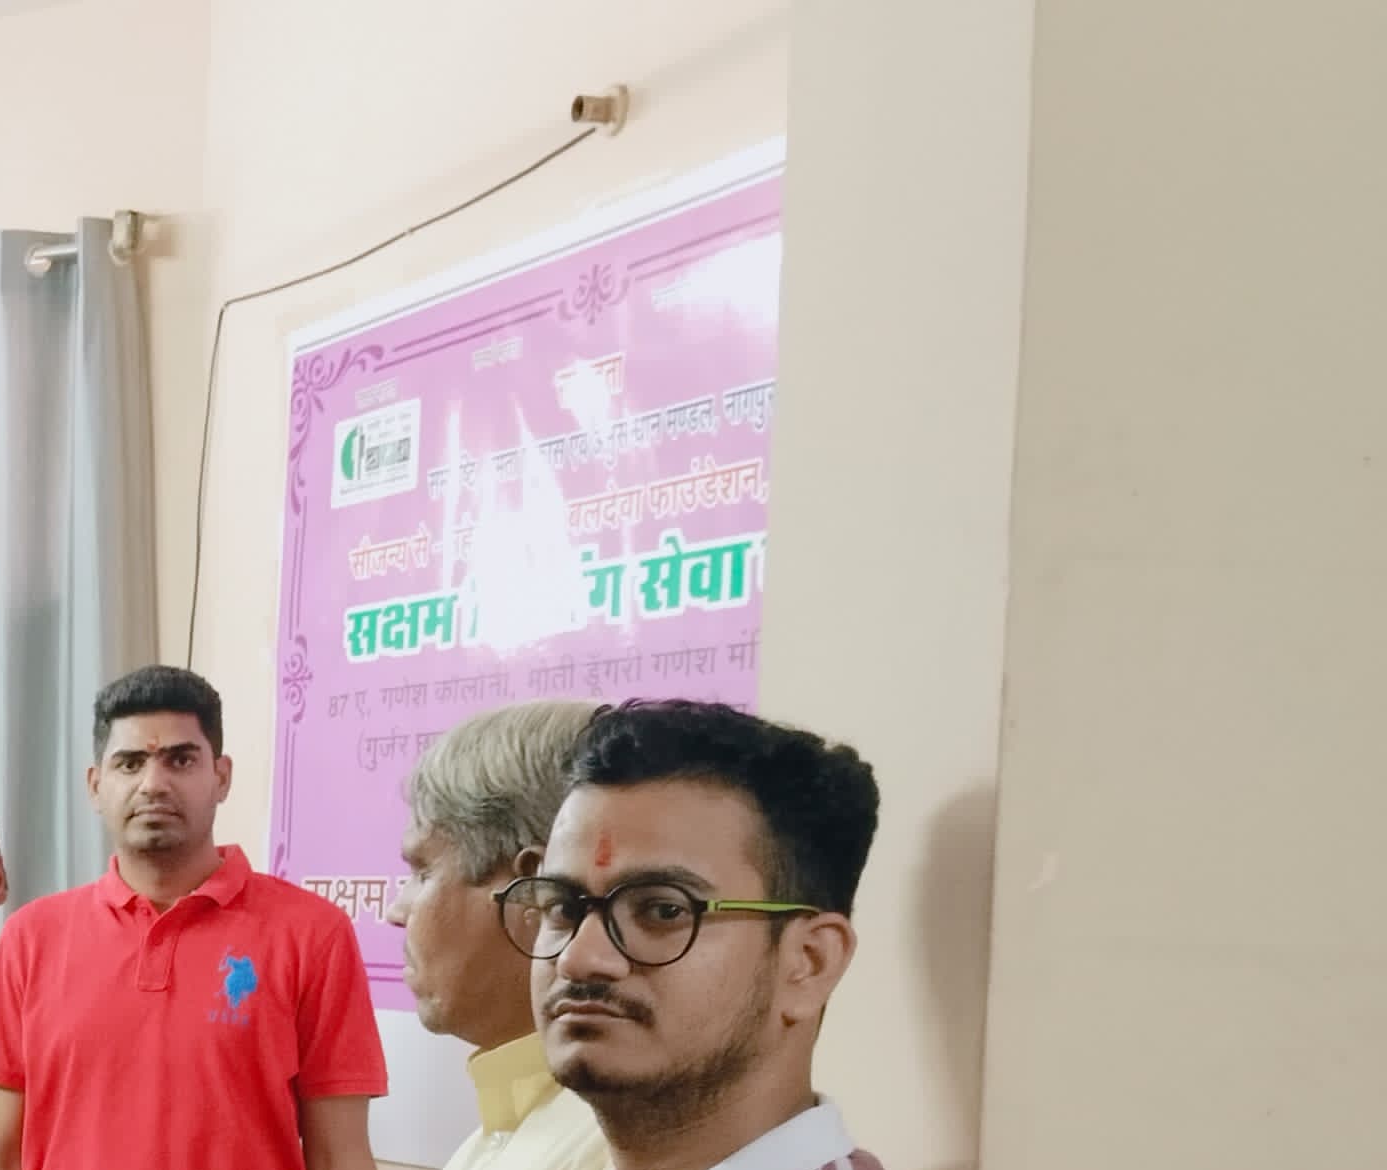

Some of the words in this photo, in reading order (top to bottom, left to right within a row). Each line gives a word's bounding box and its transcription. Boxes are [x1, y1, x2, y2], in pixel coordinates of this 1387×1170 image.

[347, 594, 458, 657] सक्षम
[639, 535, 753, 612] सेवा
[381, 676, 427, 710] गणेश
[651, 643, 719, 680] गणेश
